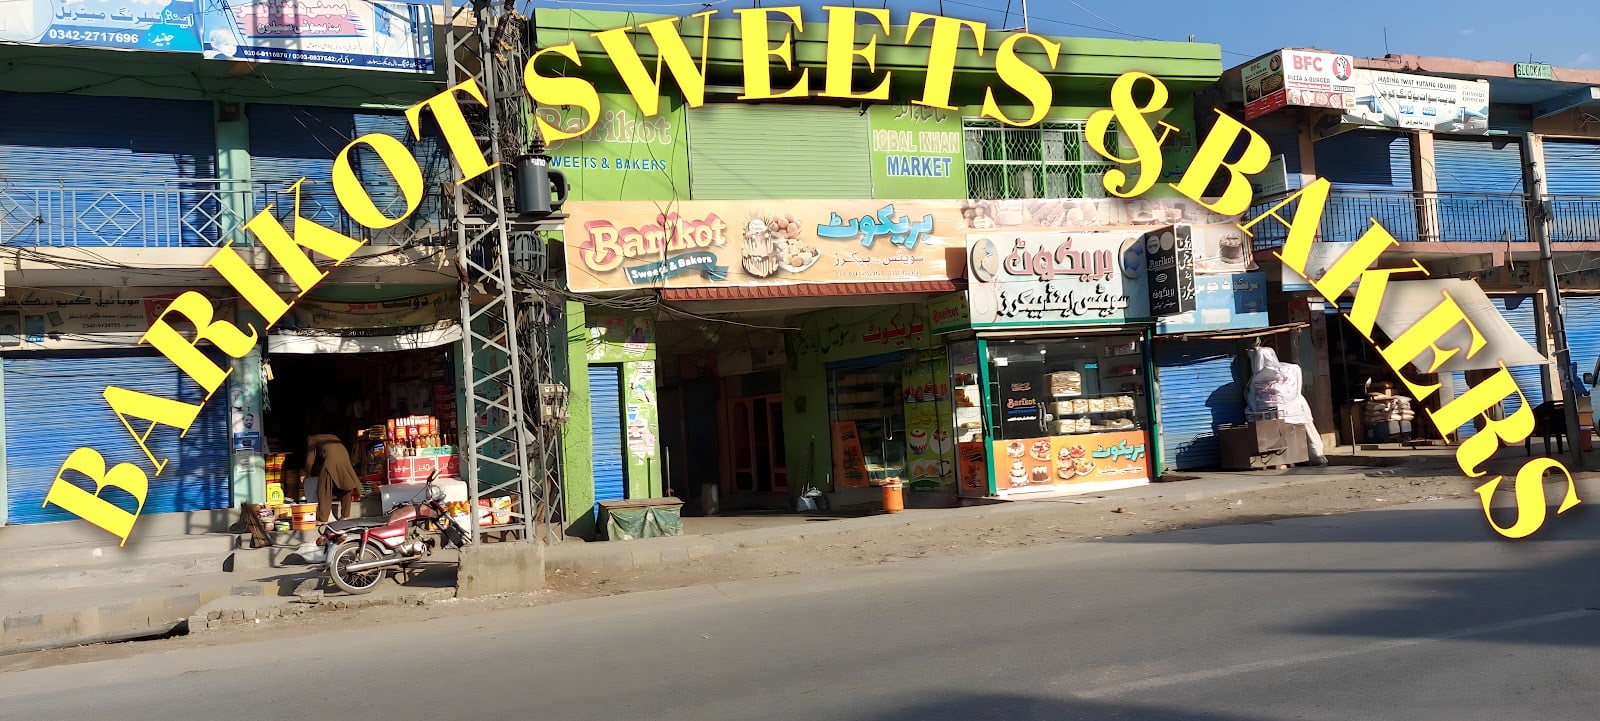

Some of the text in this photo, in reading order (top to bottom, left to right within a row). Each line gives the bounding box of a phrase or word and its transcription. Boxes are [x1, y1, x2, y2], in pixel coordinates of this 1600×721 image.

[49, 29, 139, 44] 0342-2717696
[1293, 54, 1323, 72] BFC
[873, 129, 961, 153] IQBAL KHAN
[550, 155, 598, 169] WEETS
[601, 157, 610, 170] &
[616, 158, 667, 171] BAKERS
[886, 155, 953, 178] MARKET
[817, 204, 934, 250] بریکوٹ
[579, 211, 728, 272] Barikot
[669, 261, 678, 272] &
[678, 255, 713, 269] Bakers
[1004, 236, 1116, 283] بریکوٹ
[862, 307, 925, 346] بریکوٹ
[1007, 397, 1037, 409] Barikot
[1091, 438, 1145, 463] بریکوٹ
